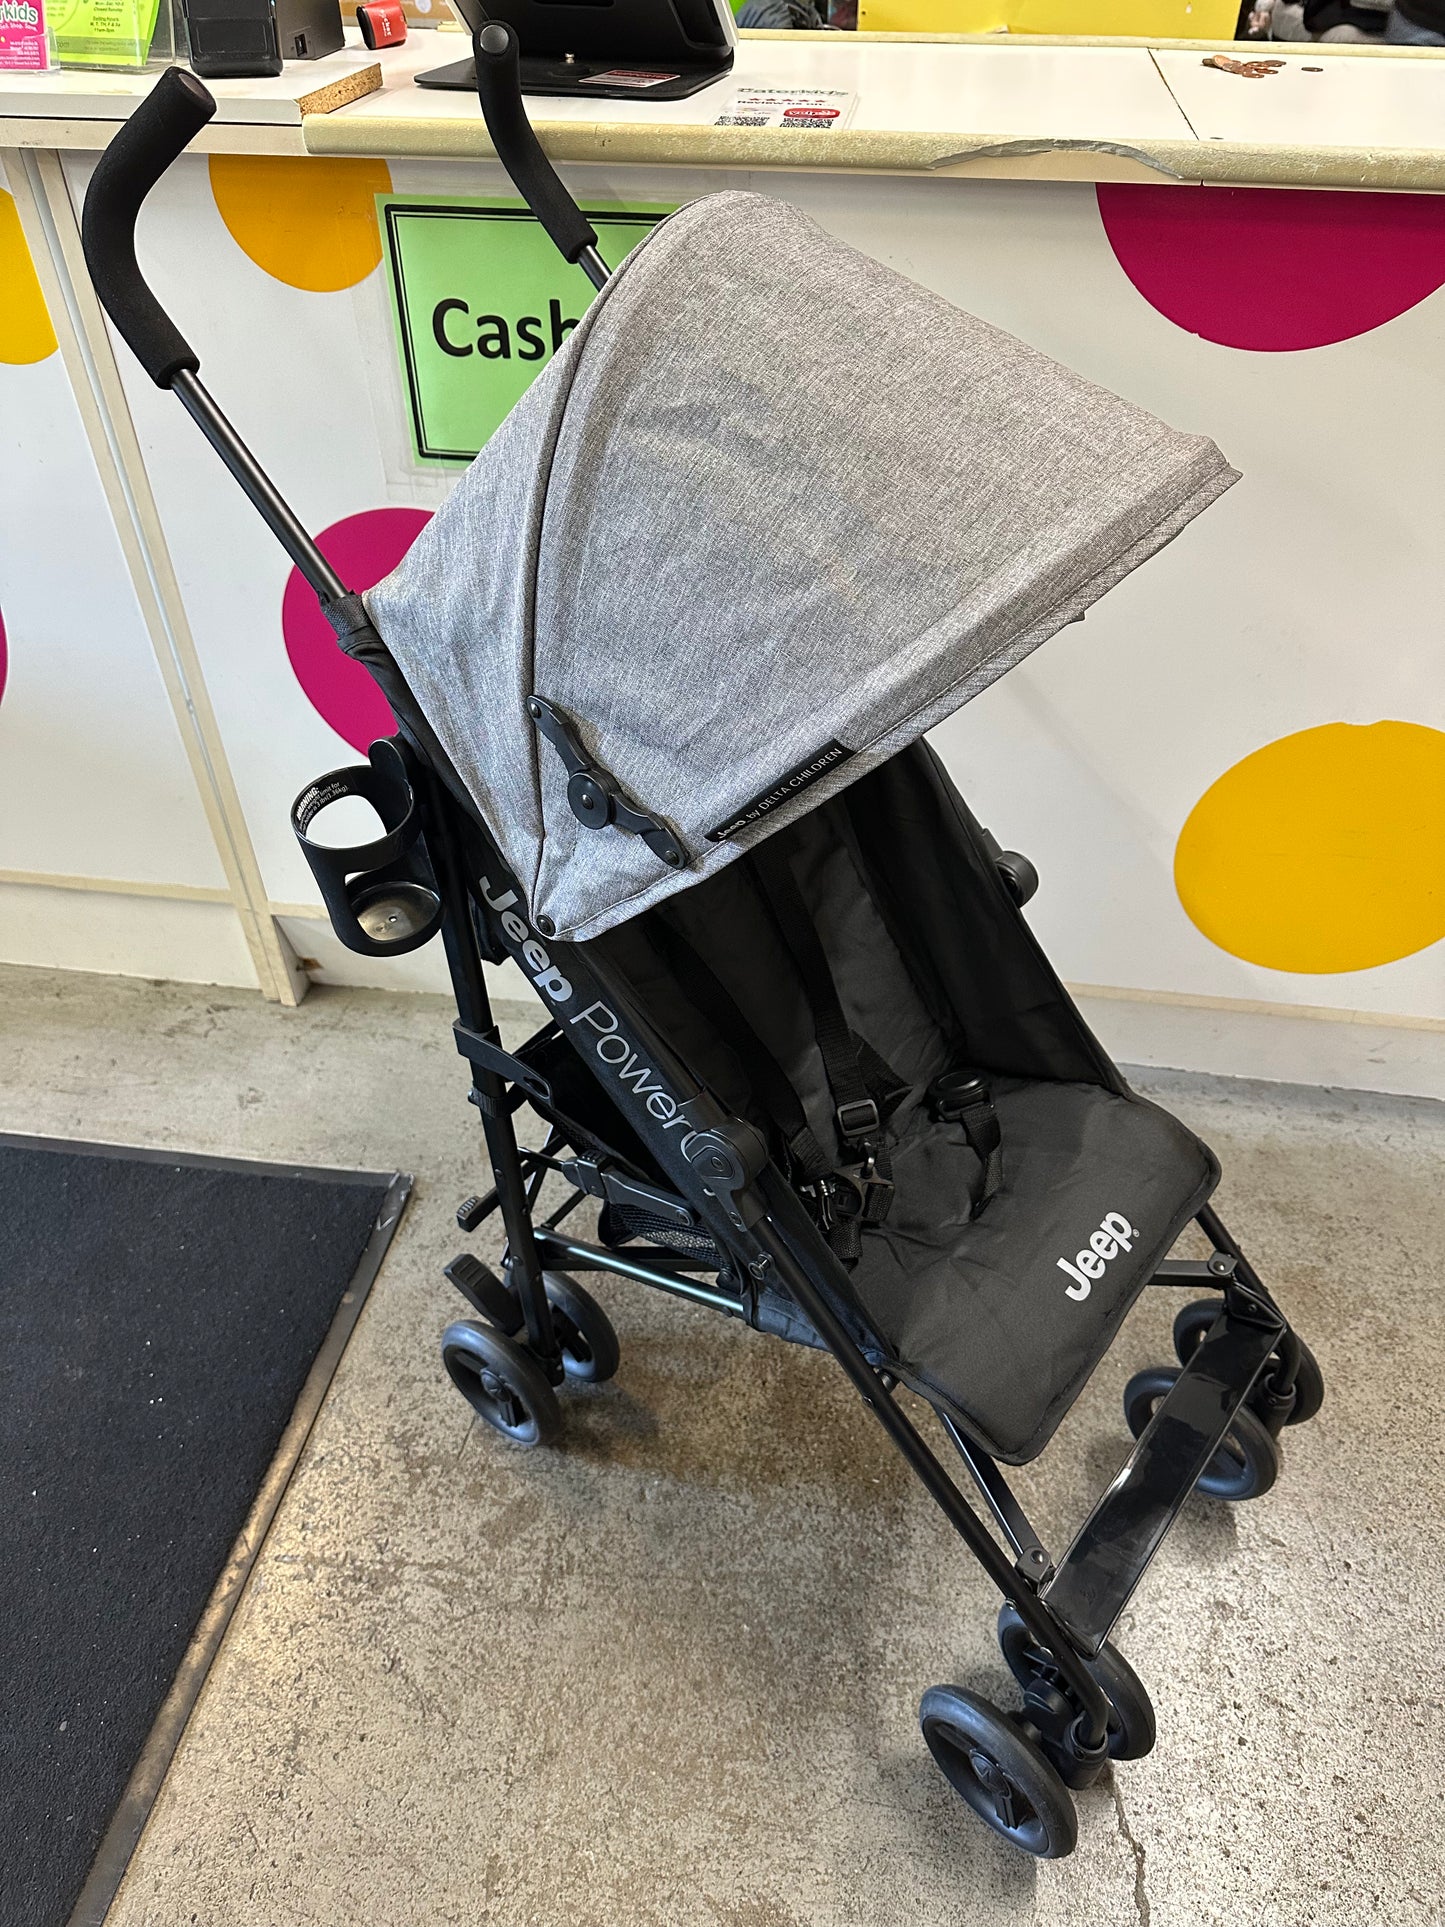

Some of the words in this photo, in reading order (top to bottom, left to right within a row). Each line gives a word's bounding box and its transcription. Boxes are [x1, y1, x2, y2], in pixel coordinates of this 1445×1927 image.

[746, 809, 761, 820] by
[758, 787, 791, 810] DELTA
[789, 748, 842, 788] CHILDREN
[478, 875, 573, 1002] Jeep
